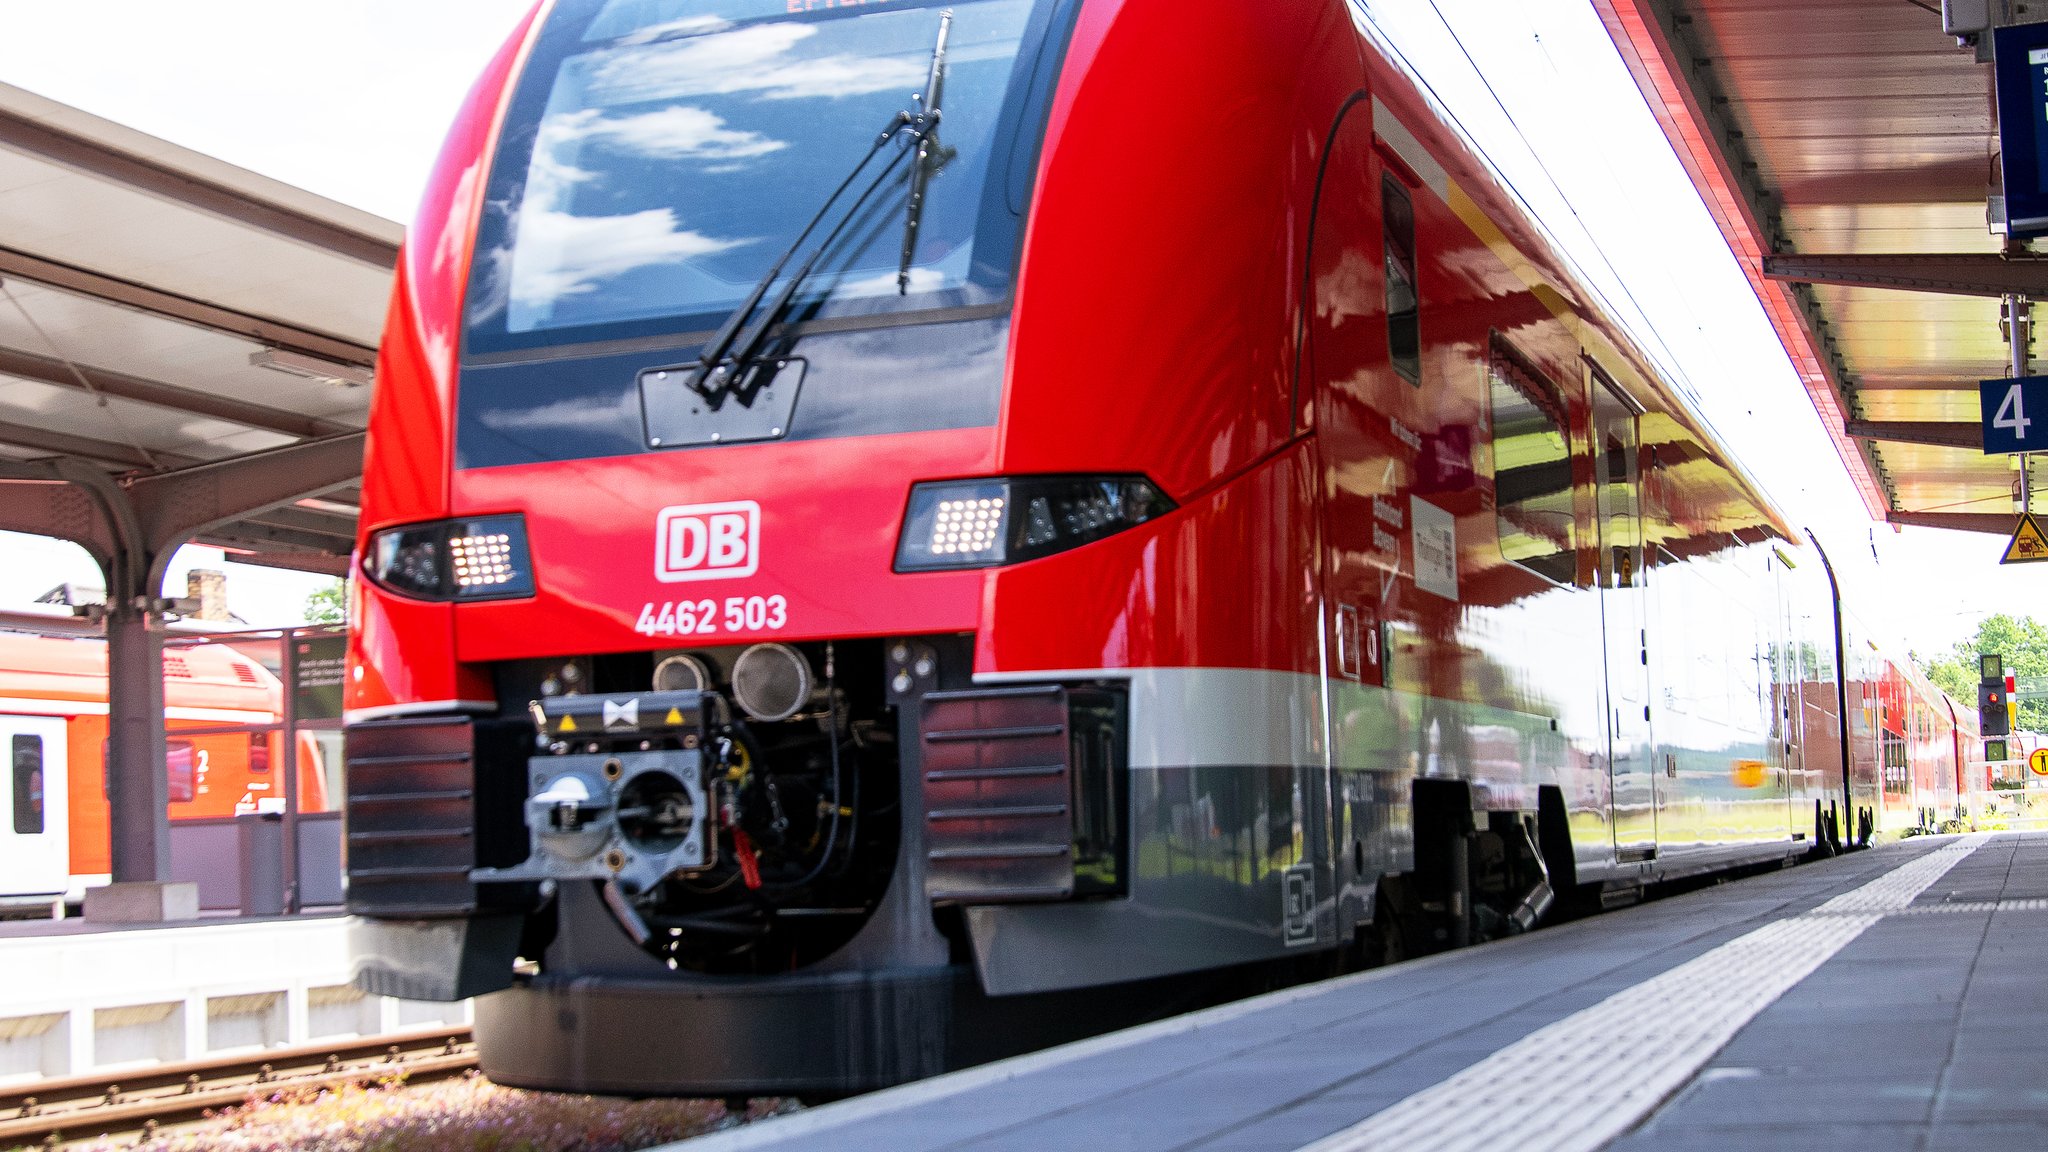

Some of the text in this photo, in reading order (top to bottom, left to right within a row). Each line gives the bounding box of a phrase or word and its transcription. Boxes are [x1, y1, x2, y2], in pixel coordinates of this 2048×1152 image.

[1993, 384, 2031, 439] 4
[667, 512, 748, 571] DB
[634, 594, 787, 637] 4462 503
[197, 749, 209, 770] 2
